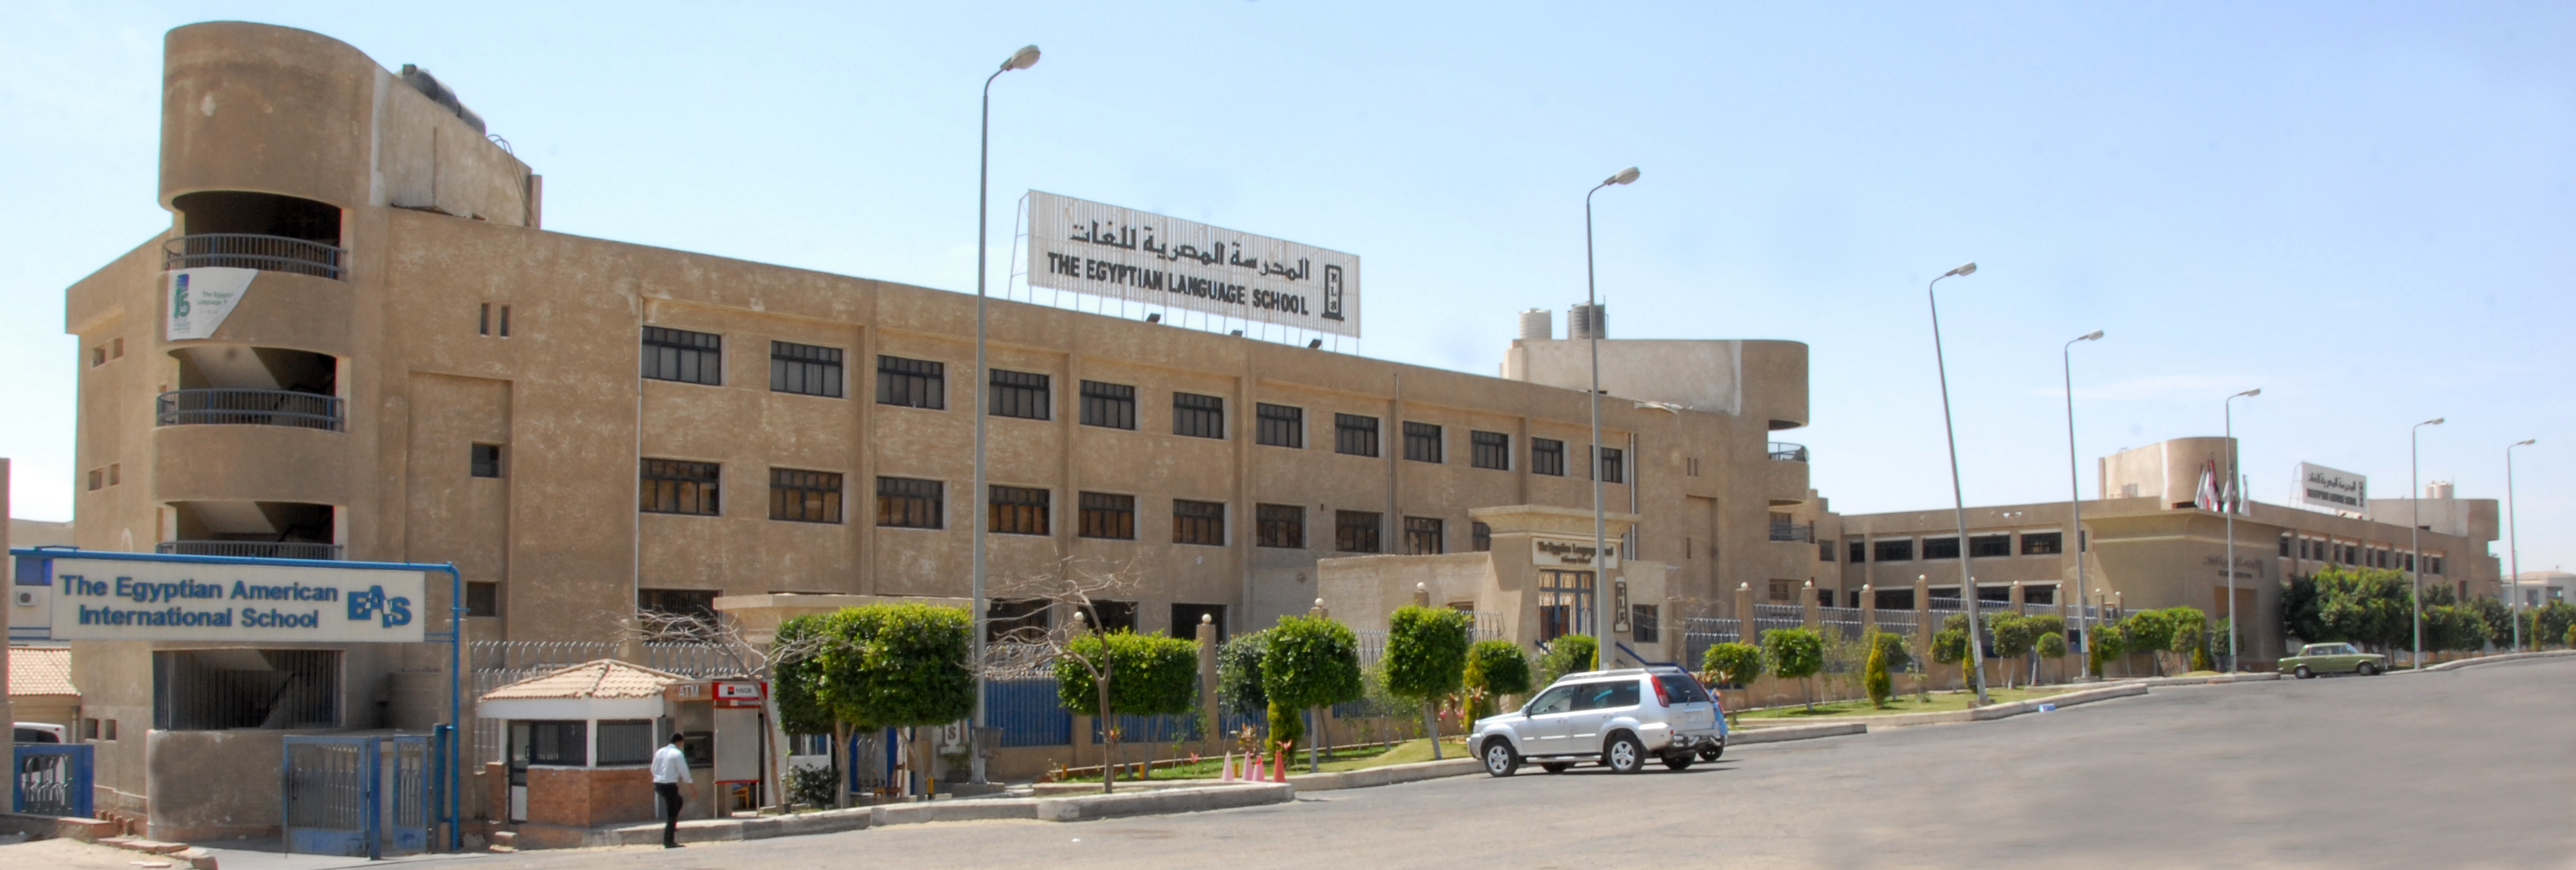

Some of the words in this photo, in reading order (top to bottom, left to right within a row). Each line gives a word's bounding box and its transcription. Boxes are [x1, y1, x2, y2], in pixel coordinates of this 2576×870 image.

[1070, 219, 1136, 250] للغات
[1144, 226, 1225, 265] المصرية
[1230, 241, 1309, 281] المدرسة
[1048, 252, 1080, 277] THE
[1086, 259, 1163, 291] EGYPTIAN
[1168, 273, 1245, 305] LANGUAGE
[1253, 288, 1309, 315] SCHOOL
[59, 575, 108, 596] The
[116, 576, 224, 603] Egyptian
[230, 580, 339, 601] American
[79, 605, 233, 627] International
[242, 607, 319, 628] School
[679, 685, 699, 698] ATM
